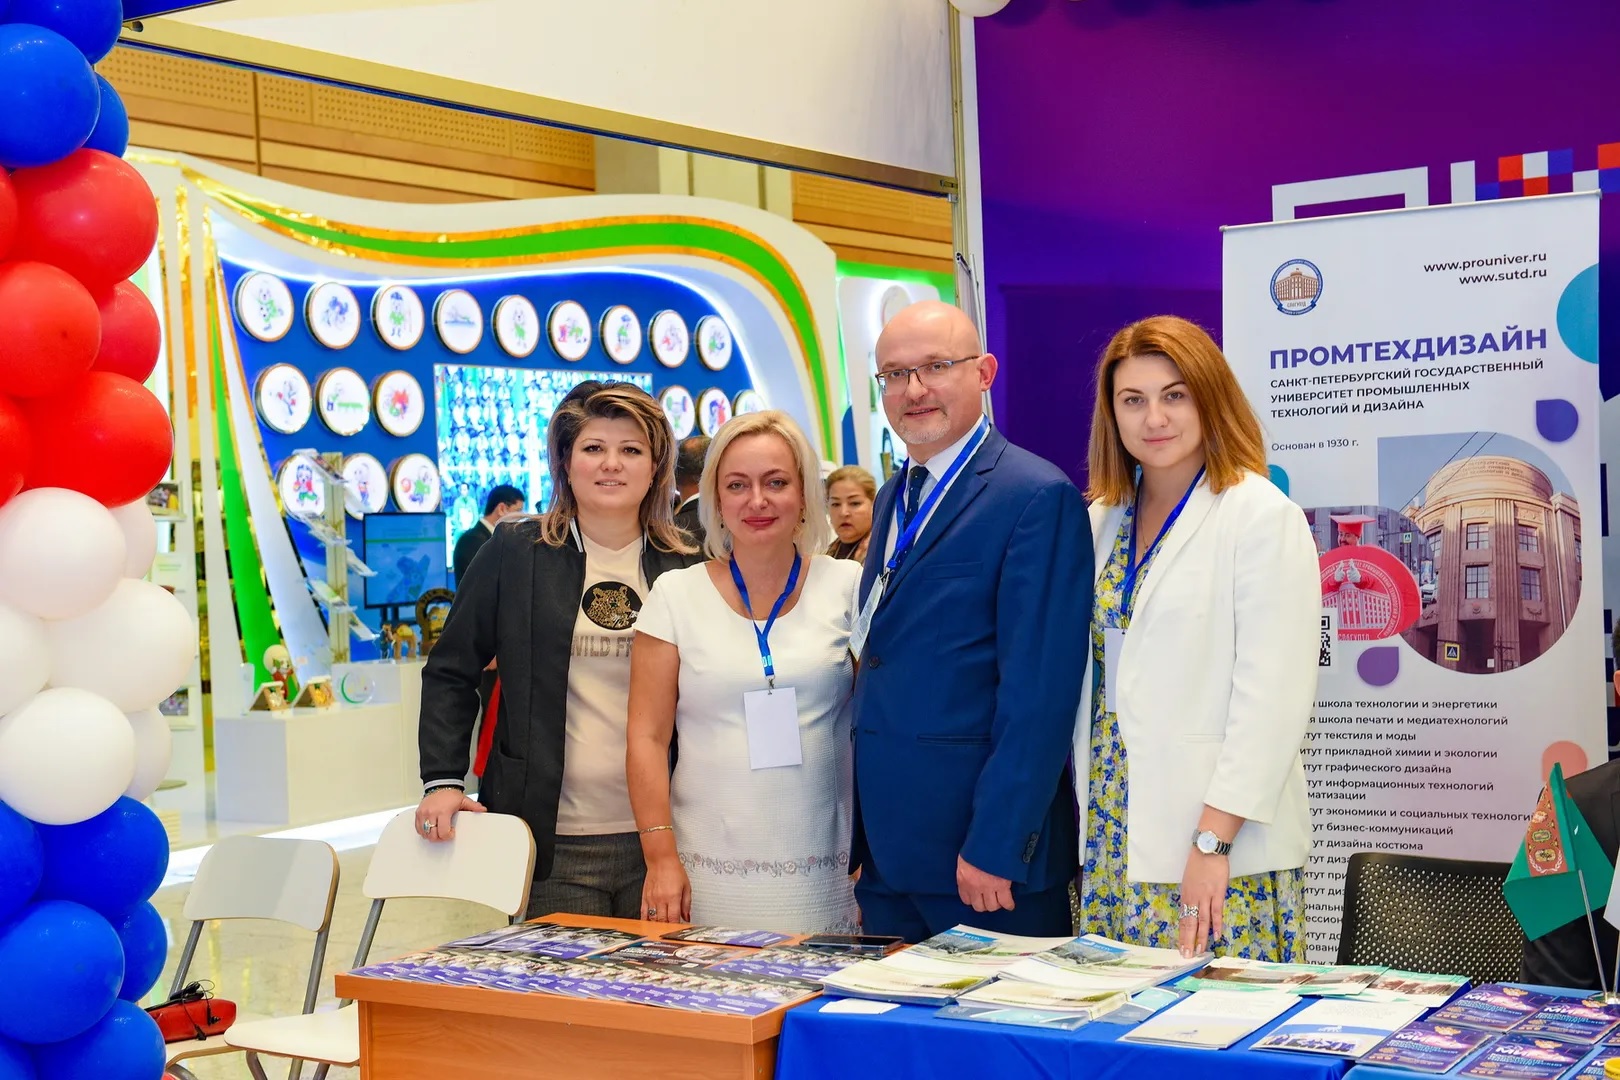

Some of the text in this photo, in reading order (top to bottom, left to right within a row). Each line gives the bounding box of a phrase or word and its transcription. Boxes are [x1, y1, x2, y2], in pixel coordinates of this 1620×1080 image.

[1423, 252, 1547, 273] www.prouniver.ru
[1459, 269, 1547, 286] www.sutd.ru
[1270, 325, 1547, 370] ПРОМТЕХДИЗАЙН
[1270, 358, 1544, 389] САНКТ-ПЕТЕРБУРГСКИЙ ГОСУДАРСТВЕННЫЙ
[1271, 381, 1470, 404] УНИВЕРСИТЕТ ПРОМЫШЛЕННЫХ
[1271, 398, 1424, 419] ТЕХНОЛОГИЙ И ДИЗАЙНА
[1271, 441, 1316, 451] Основан
[1327, 439, 1349, 449] 1930
[1355, 701, 1418, 709] технологии
[1432, 701, 1497, 710] энергетики
[1318, 716, 1352, 724] школа
[1407, 716, 1507, 725] медиатехнологий
[1386, 733, 1416, 741] моды
[1325, 748, 1391, 757] прикладной
[1444, 750, 1497, 759] экологии
[1325, 763, 1401, 773] графического
[1404, 764, 1451, 774] дизайна
[1326, 779, 1425, 790] информационных
[1428, 781, 1494, 792] технологий
[1326, 808, 1386, 817] экономики
[1400, 809, 1468, 820] социальных
[1471, 813, 1533, 821] технологи
[1326, 822, 1453, 836] бизнес-коммуникаций
[1327, 839, 1372, 848] дизайна
[1375, 841, 1423, 850] костюма
